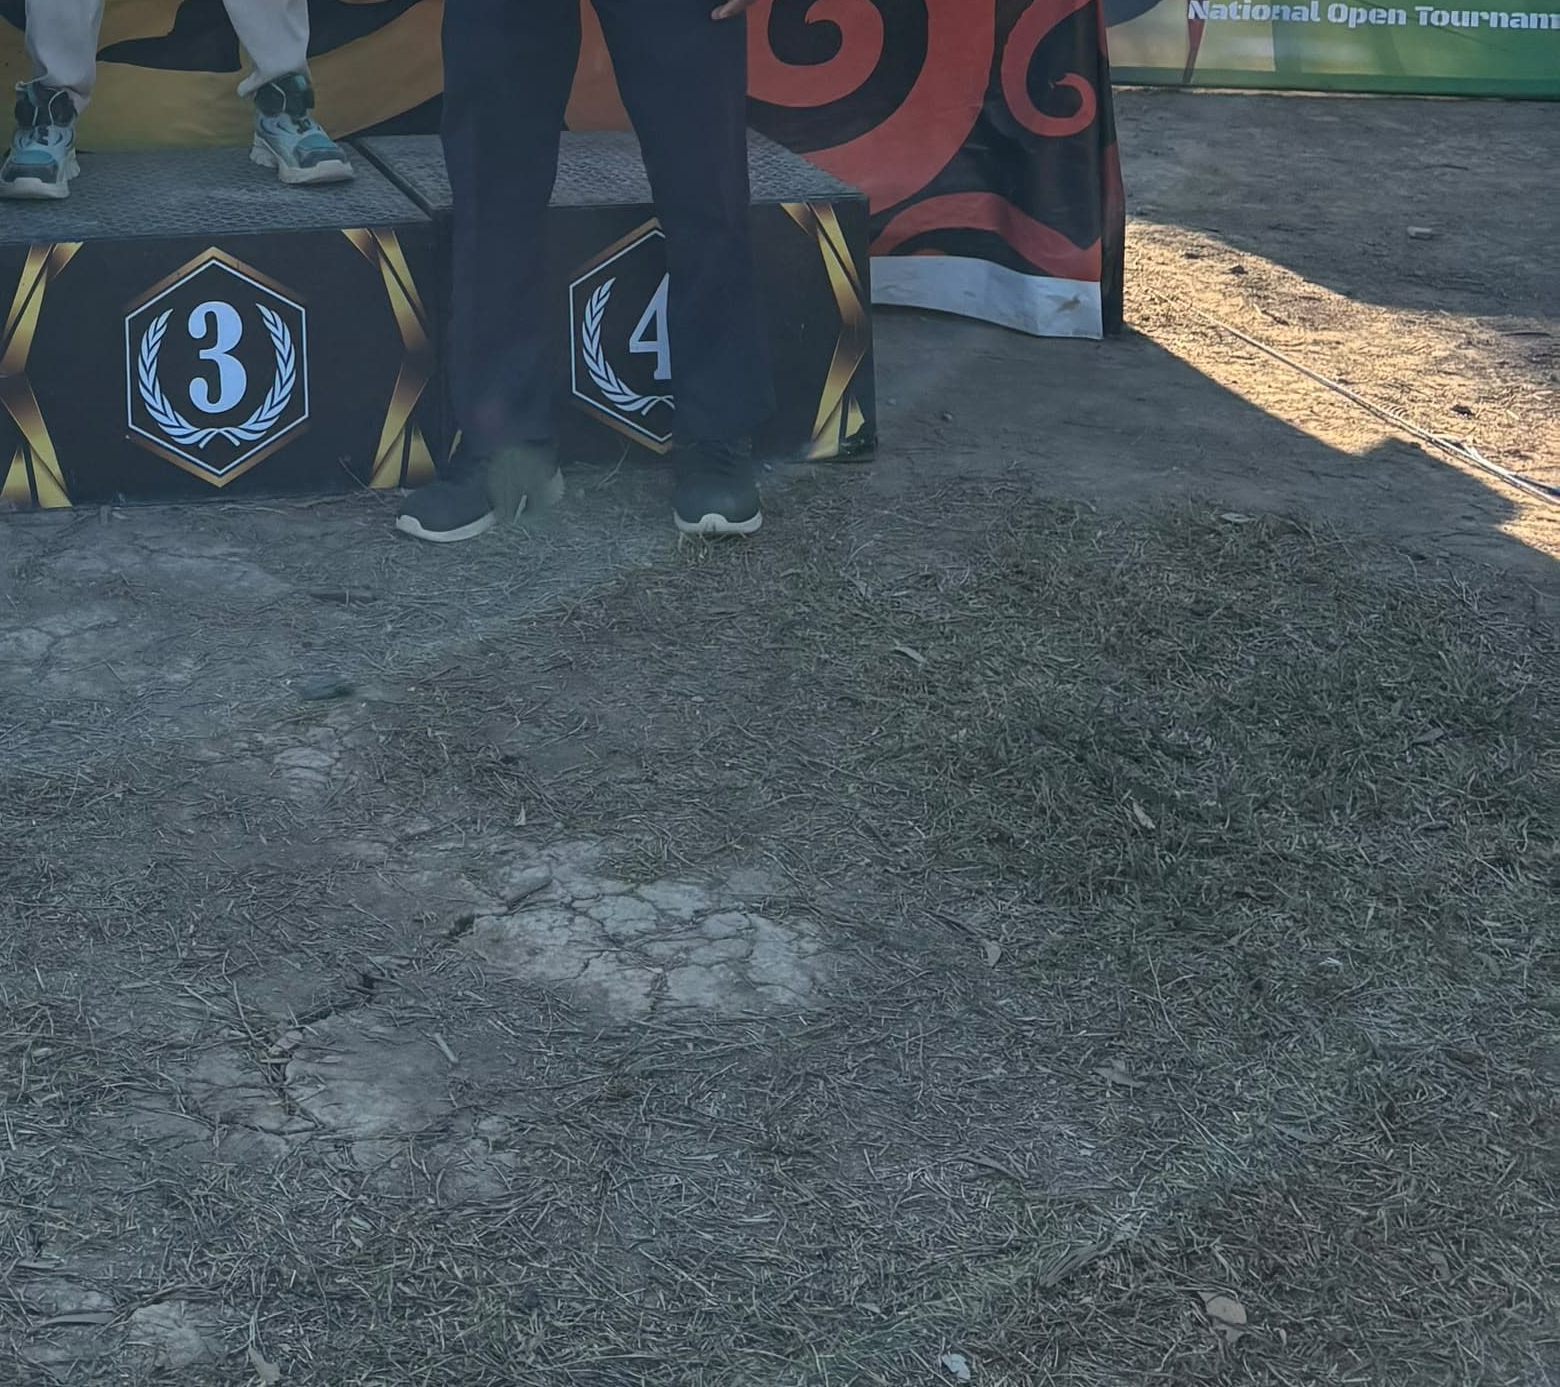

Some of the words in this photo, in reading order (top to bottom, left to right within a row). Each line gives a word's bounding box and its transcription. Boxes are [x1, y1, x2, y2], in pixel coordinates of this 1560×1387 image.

[1189, 0, 1320, 23] National
[1327, 2, 1406, 28] Open
[187, 301, 248, 415] 3
[629, 273, 672, 381] 4
